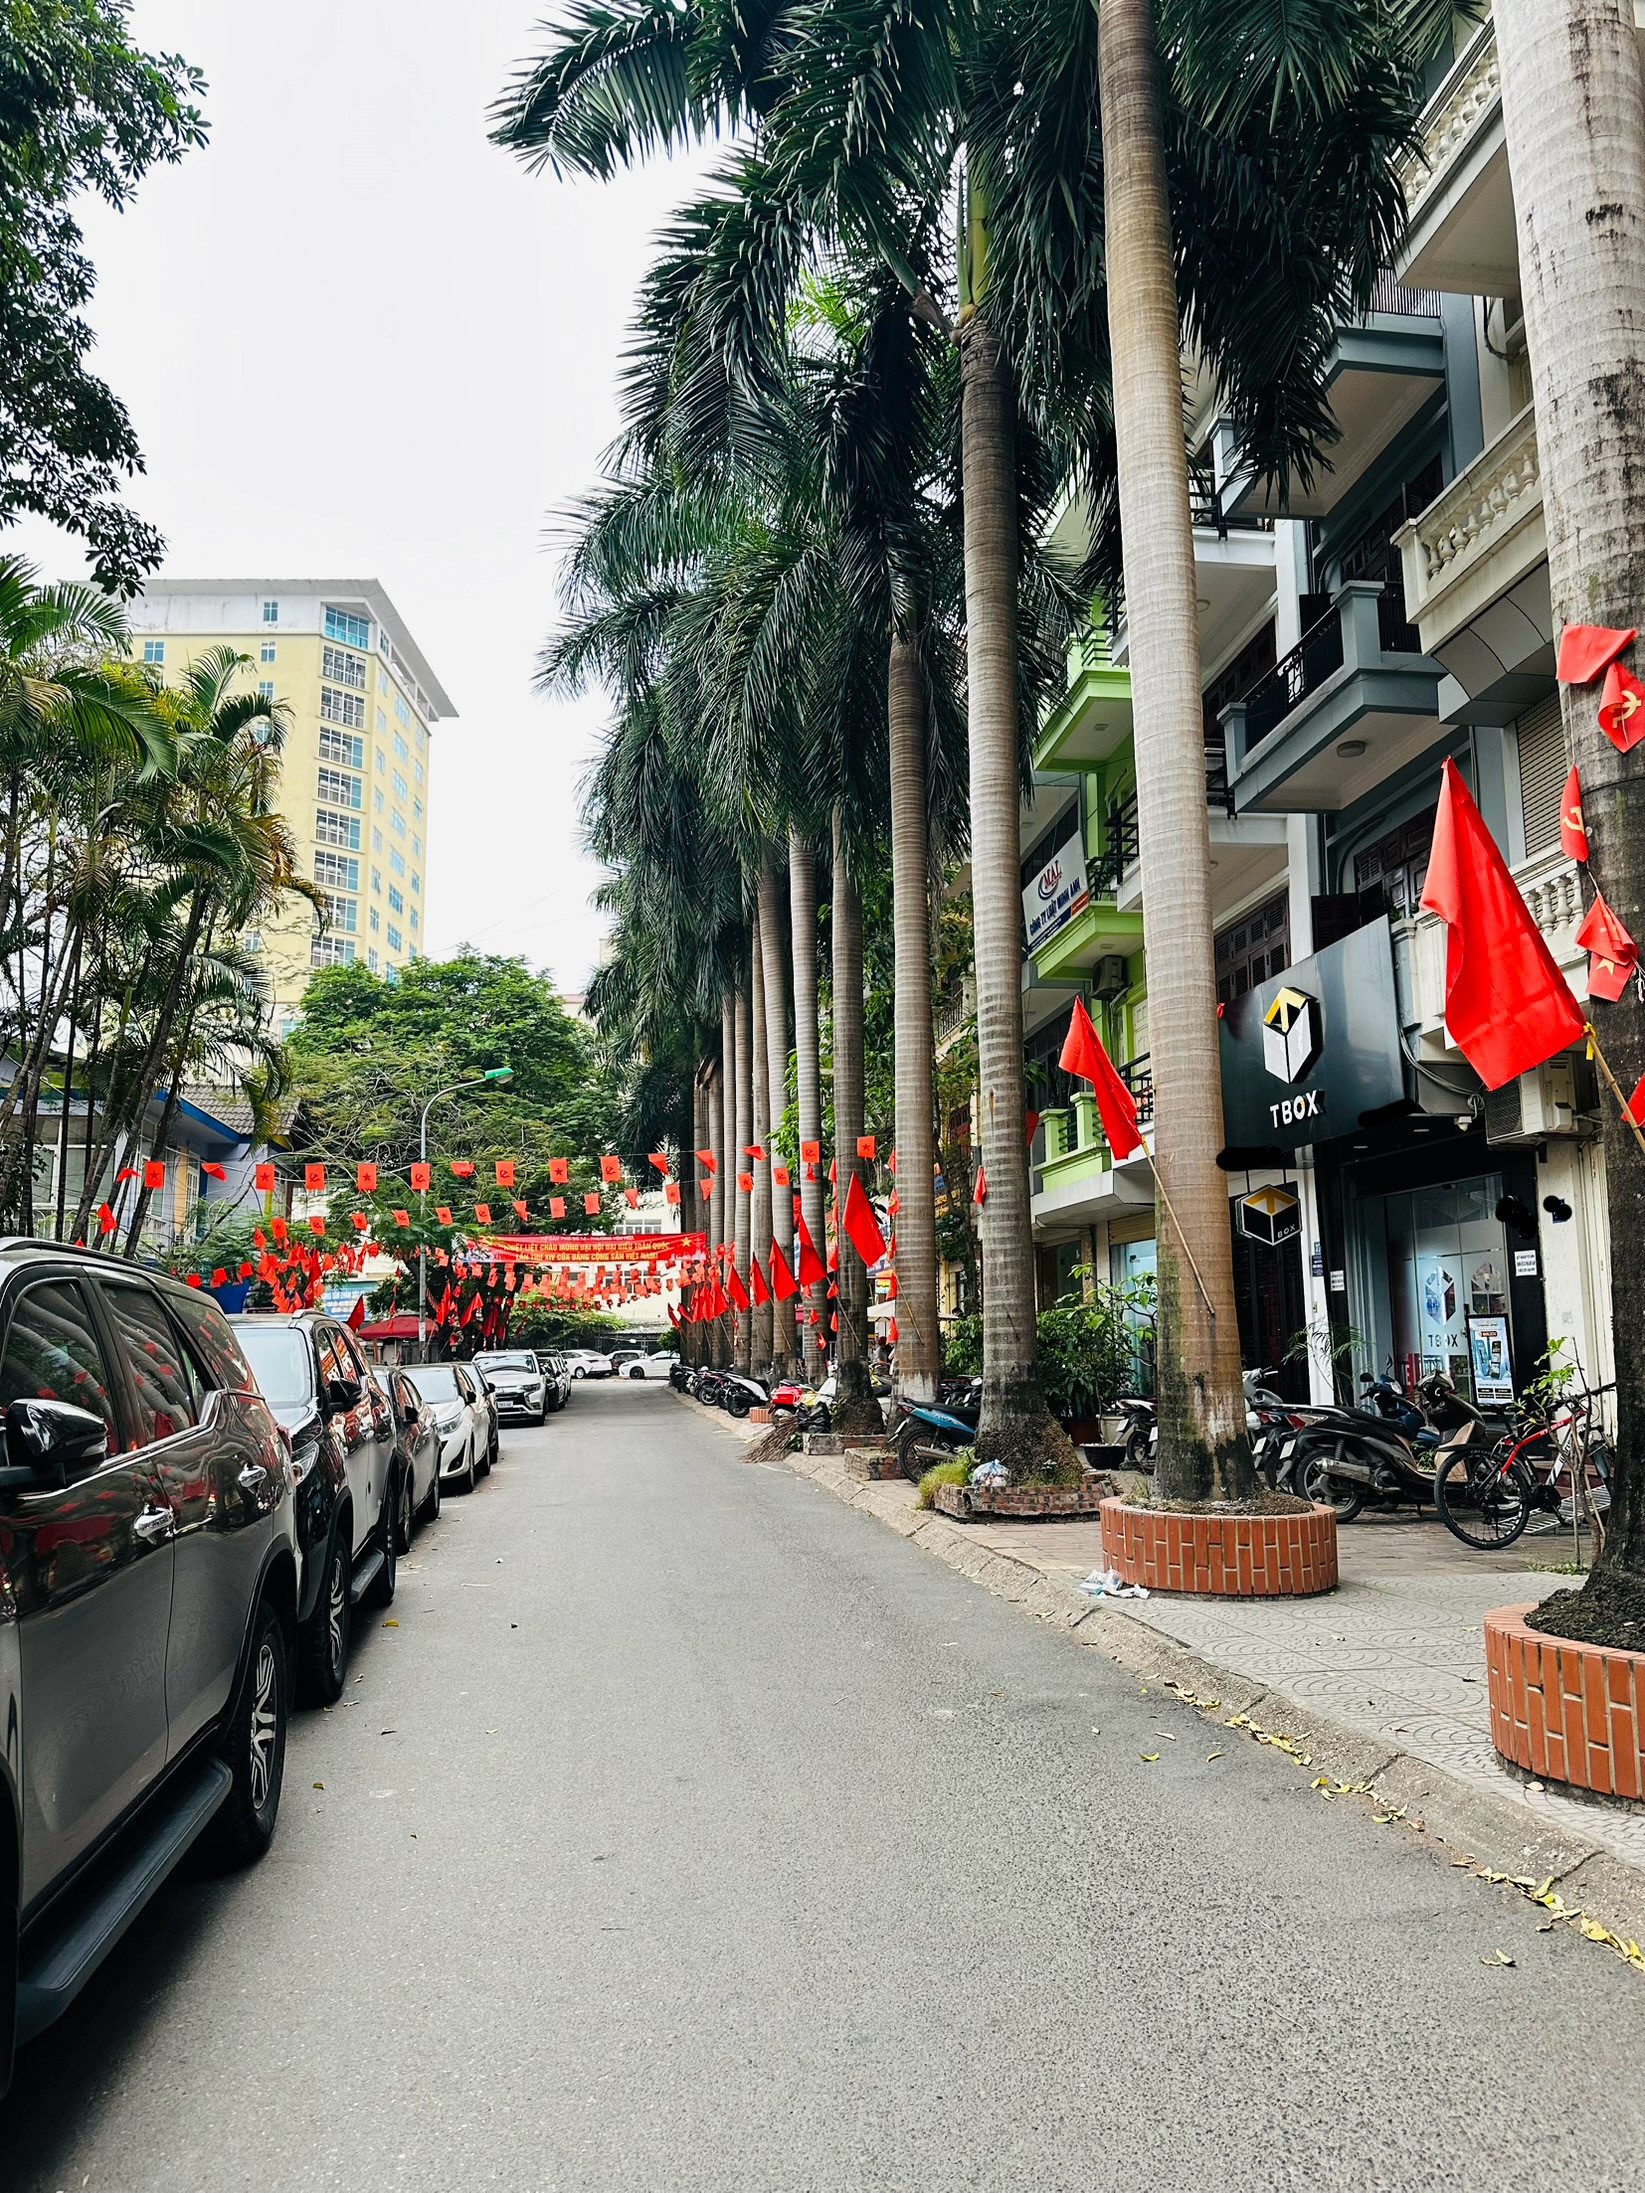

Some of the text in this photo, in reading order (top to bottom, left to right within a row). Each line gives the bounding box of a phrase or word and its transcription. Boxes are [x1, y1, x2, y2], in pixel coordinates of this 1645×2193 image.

[1040, 911, 1048, 924] TY
[1269, 1089, 1321, 1129] TBOX
[1277, 1223, 1296, 1239] BOX
